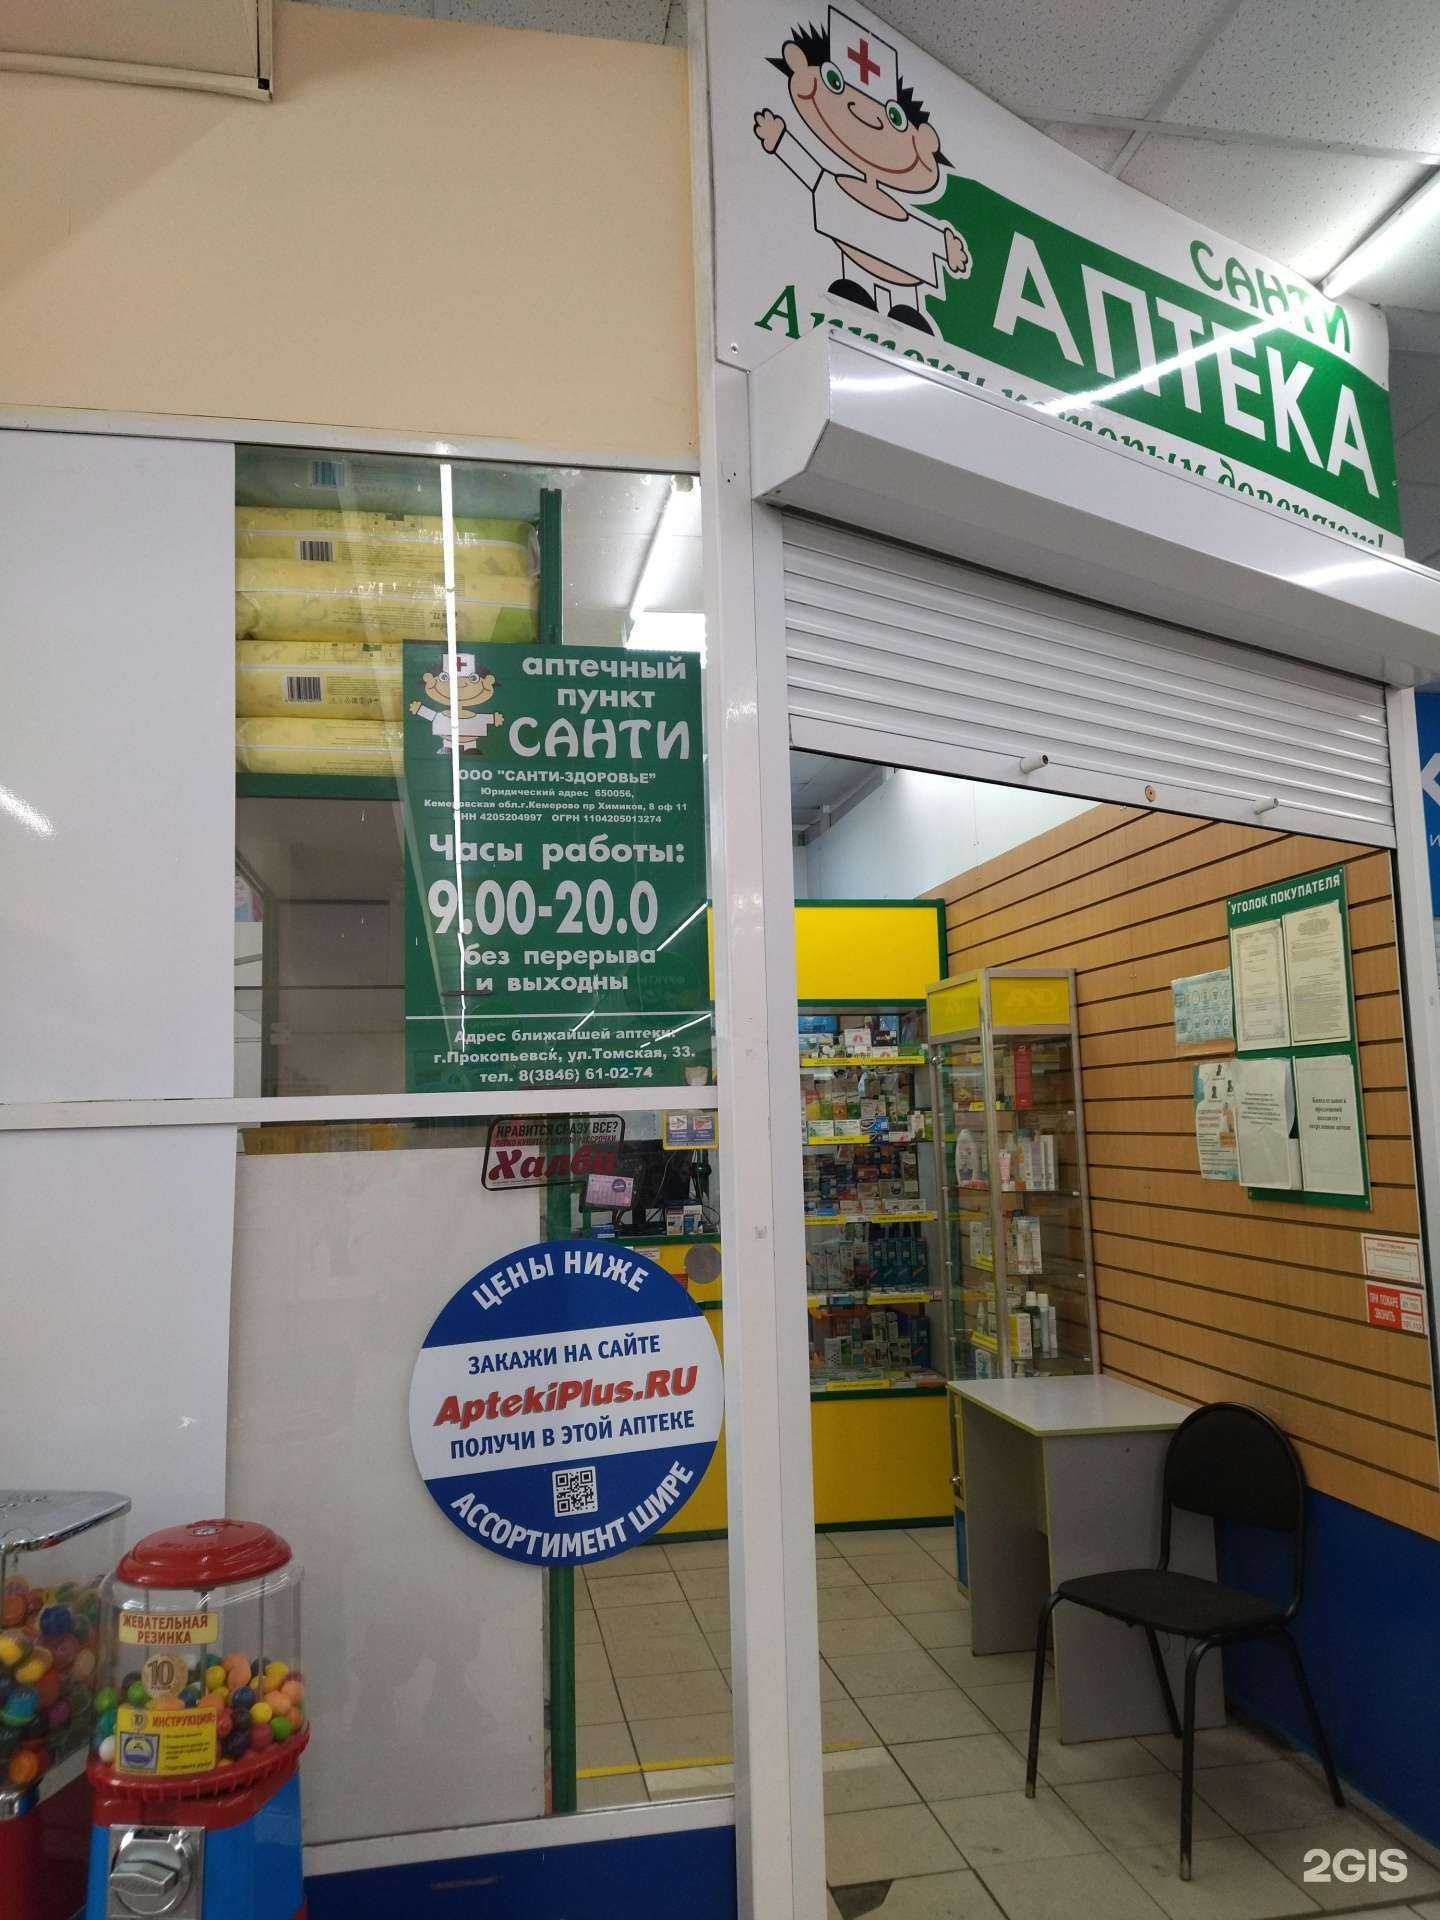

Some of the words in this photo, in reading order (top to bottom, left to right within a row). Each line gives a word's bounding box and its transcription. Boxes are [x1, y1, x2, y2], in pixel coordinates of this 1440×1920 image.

[992, 231, 1381, 499] АПТЕКА
[522, 656, 687, 680] аптечный
[557, 688, 656, 714] пункт
[508, 716, 691, 760] САНТИ
[481, 787, 555, 797] Юридический
[559, 789, 589, 798] адрес
[454, 812, 477, 821] НН
[480, 813, 543, 822] 4205204997
[551, 814, 580, 823] ОГРН
[583, 803, 596, 812] пр
[649, 802, 656, 811] 8
[657, 802, 674, 812] оф
[676, 803, 688, 811] 11
[429, 834, 523, 862] Часы
[542, 833, 685, 870] работы:
[427, 879, 659, 936] 9.00-20.0
[1231, 895, 1269, 915] УГОЛОК
[1270, 874, 1341, 905] ПОКУПАТЕЛЯ
[464, 943, 510, 966] без
[524, 948, 656, 970] перерыва
[475, 976, 493, 991] и
[507, 975, 628, 993] выходны
[454, 1030, 507, 1045] Адрес
[511, 1028, 611, 1041] ближайшей
[433, 1050, 563, 1066] г.Прокопьевск,
[567, 1047, 668, 1063] ул.Томская,
[672, 1045, 696, 1058] 33.
[479, 1072, 514, 1083] тел.
[519, 1069, 580, 1084] 8(3846)
[585, 1066, 654, 1080] 61-02-74
[592, 1121, 619, 1134] ВСЕ?
[471, 1253, 555, 1311] ЦЕНЫ
[564, 1250, 649, 1293] НИЖЕ
[468, 1346, 557, 1375] ЗАКАЖИ
[563, 1343, 593, 1364] НА
[598, 1332, 661, 1360] САЙТЕ
[432, 1365, 698, 1430] AptekiPlus.RU
[450, 1430, 536, 1459] ПОЛУЧИ
[542, 1427, 555, 1447] В
[561, 1415, 613, 1445] ЭТОЙ
[619, 1409, 695, 1437] АПТЕКЕ
[450, 1492, 629, 1558] АССОРТИМЕНТ
[627, 1459, 694, 1534] ШИРЕ
[122, 1615, 209, 1630] ЖЕВАТЕЛЬНАЯ
[137, 1631, 192, 1644] РЕЗИНКА
[148, 1660, 175, 1687] 10
